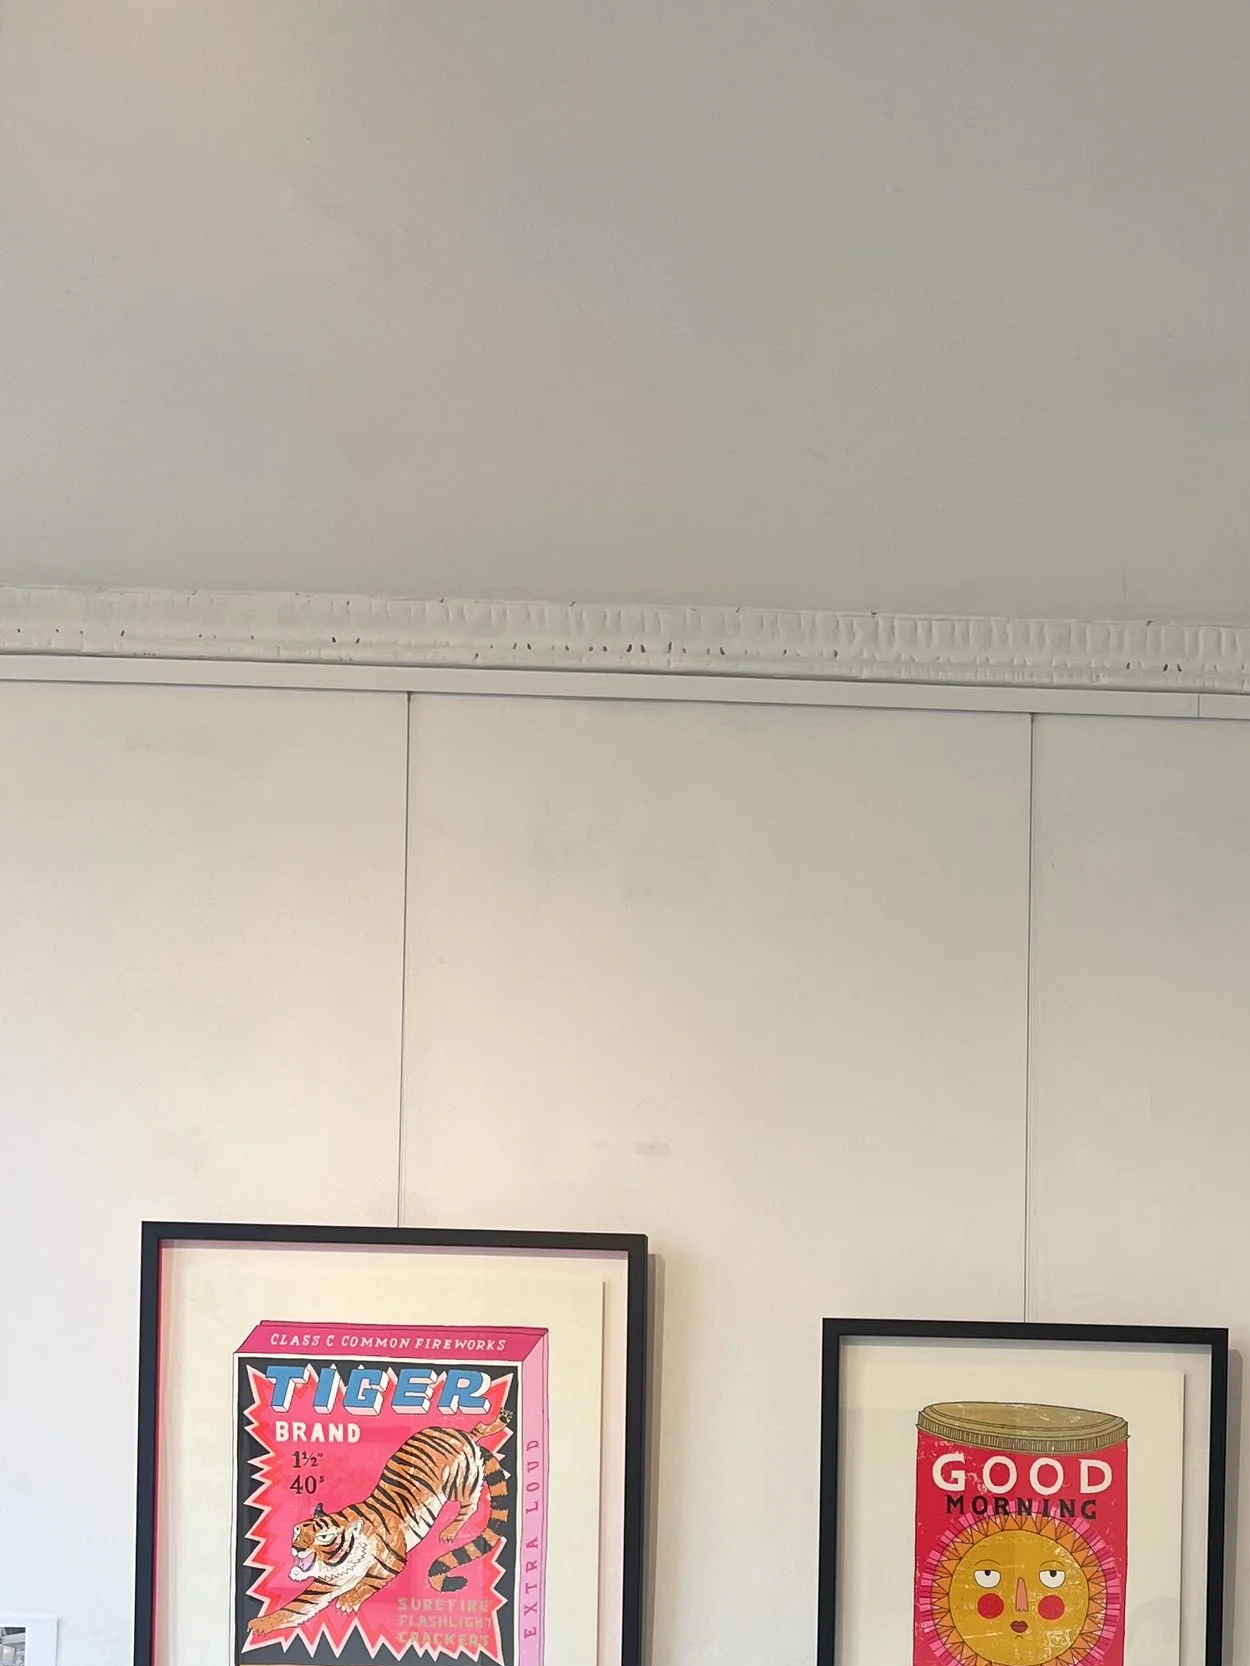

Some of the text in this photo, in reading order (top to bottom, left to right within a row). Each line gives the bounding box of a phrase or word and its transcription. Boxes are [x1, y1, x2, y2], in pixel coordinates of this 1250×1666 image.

[270, 1333, 507, 1351] CLASS C COMMON FIREWORKS
[265, 1365, 492, 1416] TIGER
[275, 1421, 361, 1443] BRAND
[932, 1452, 1112, 1495] GOOD
[945, 1494, 1096, 1520] MORNING
[524, 1440, 540, 1639] EXTRA LOUD
[400, 1614, 493, 1629] FLASHLIGHT
[398, 1631, 489, 1646] CRACKERS
